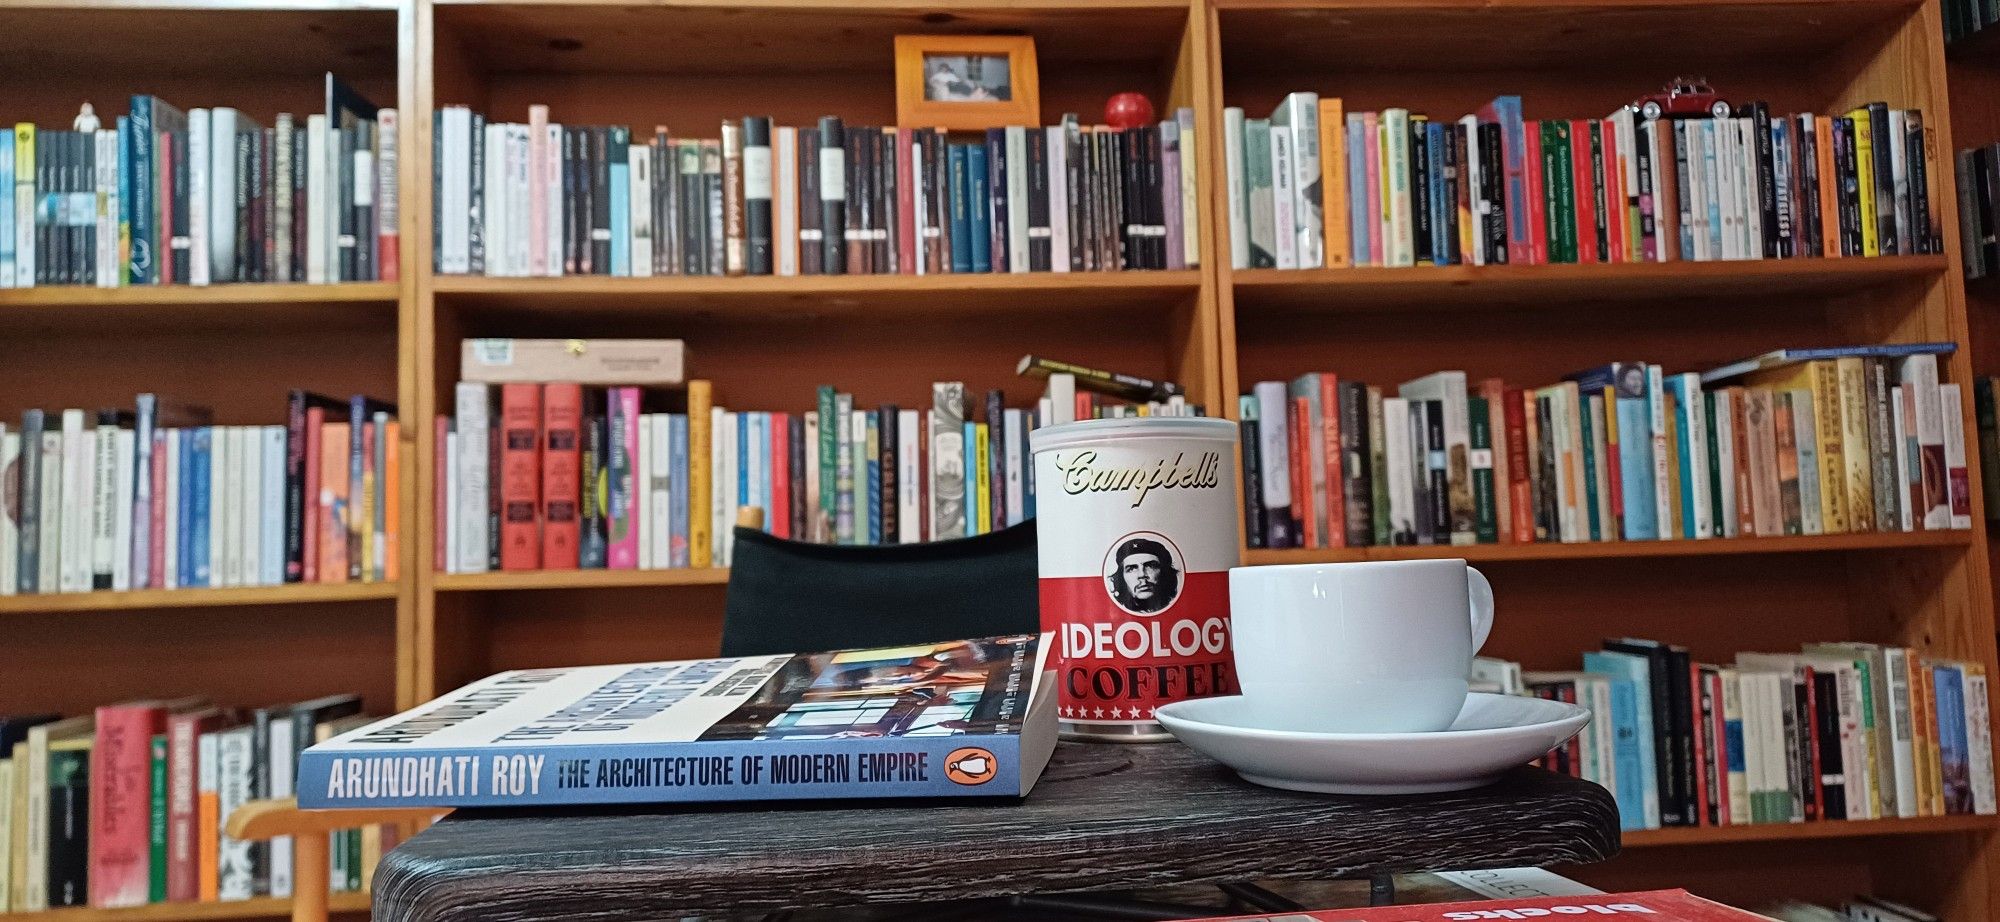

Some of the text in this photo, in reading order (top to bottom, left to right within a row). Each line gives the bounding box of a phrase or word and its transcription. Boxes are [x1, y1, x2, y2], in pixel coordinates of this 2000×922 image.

[1777, 180, 1790, 238] FATELESS
[1066, 661, 1230, 700] COFFEE
[328, 752, 929, 799] ARUNDHATI ROY THE ARCHITECTURE OF MODERN EMPIRE
[1442, 903, 1659, 921] blocks
